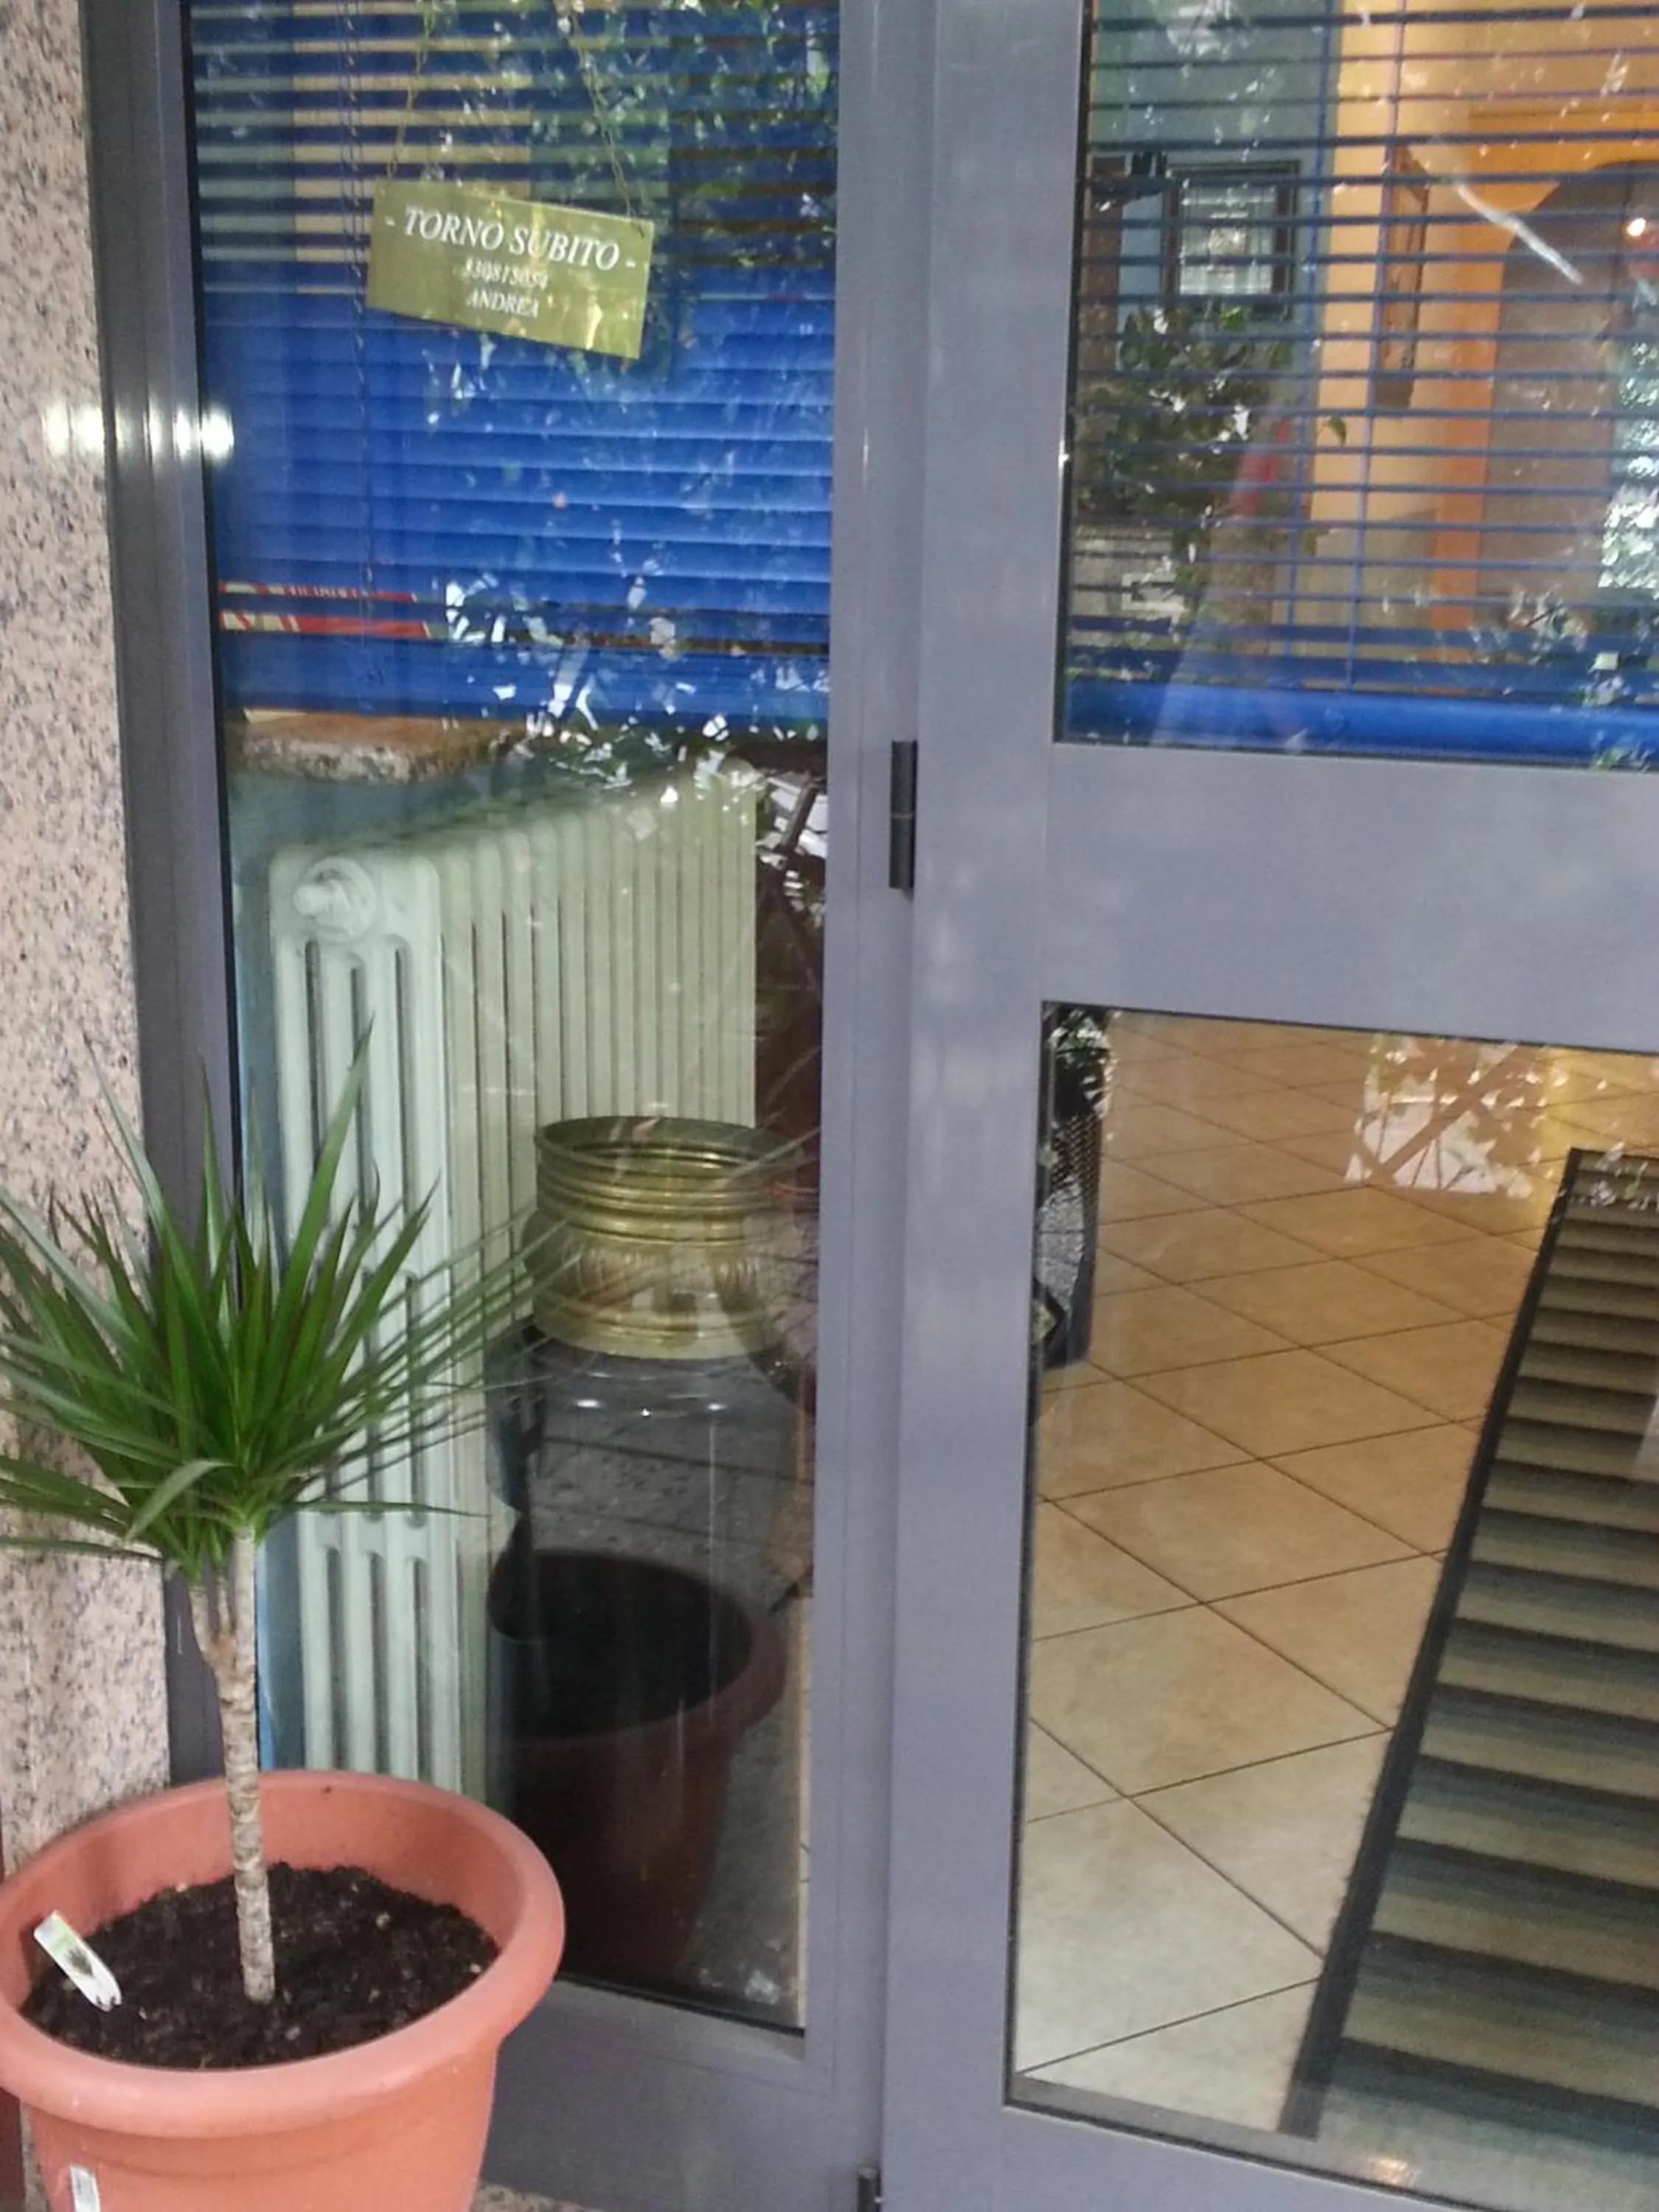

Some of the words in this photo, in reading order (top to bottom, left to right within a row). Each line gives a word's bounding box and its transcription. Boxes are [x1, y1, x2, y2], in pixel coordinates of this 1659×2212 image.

[403, 206, 504, 251] TORNO
[509, 226, 620, 271] SUBITO
[466, 289, 539, 319] ANDREA
